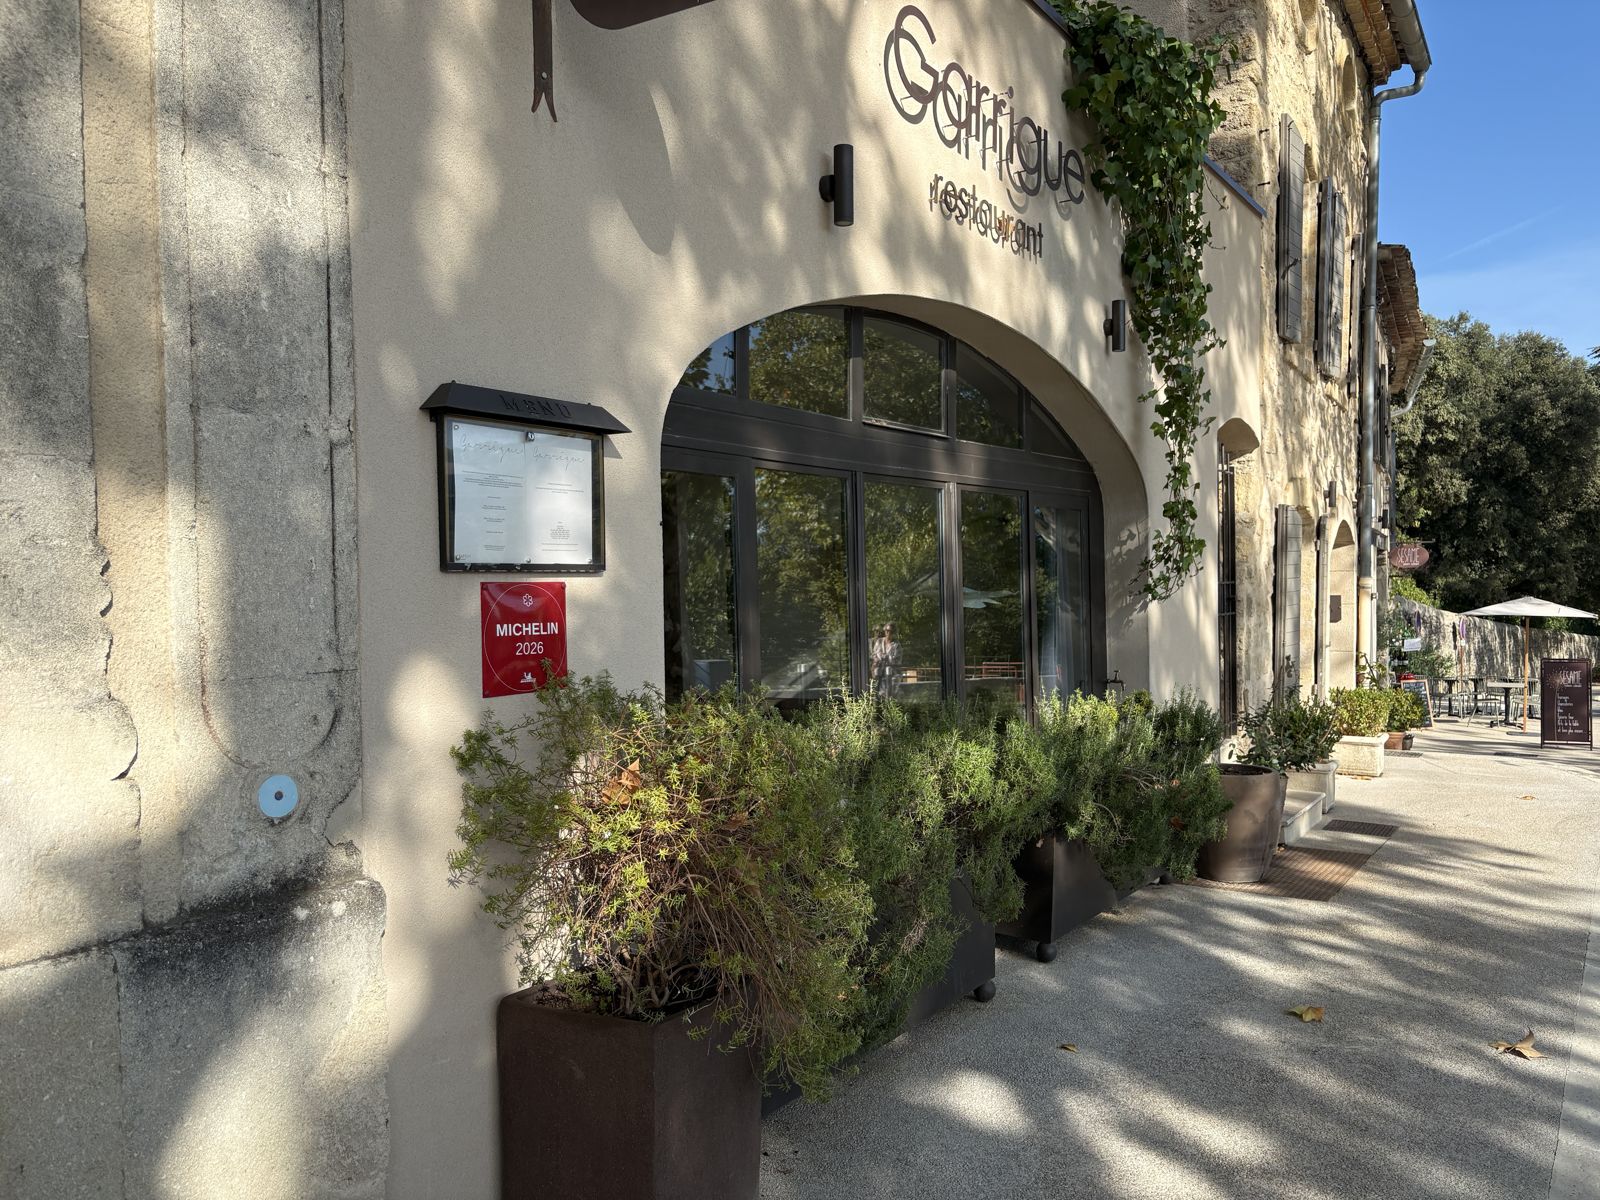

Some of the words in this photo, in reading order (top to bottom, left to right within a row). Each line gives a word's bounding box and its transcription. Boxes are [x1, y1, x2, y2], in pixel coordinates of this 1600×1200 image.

[893, 4, 1086, 205] Garrigue
[932, 173, 1044, 259] restaurant
[499, 394, 574, 419] MENU
[496, 622, 559, 637] MICHELIN
[515, 641, 544, 656] 2026
